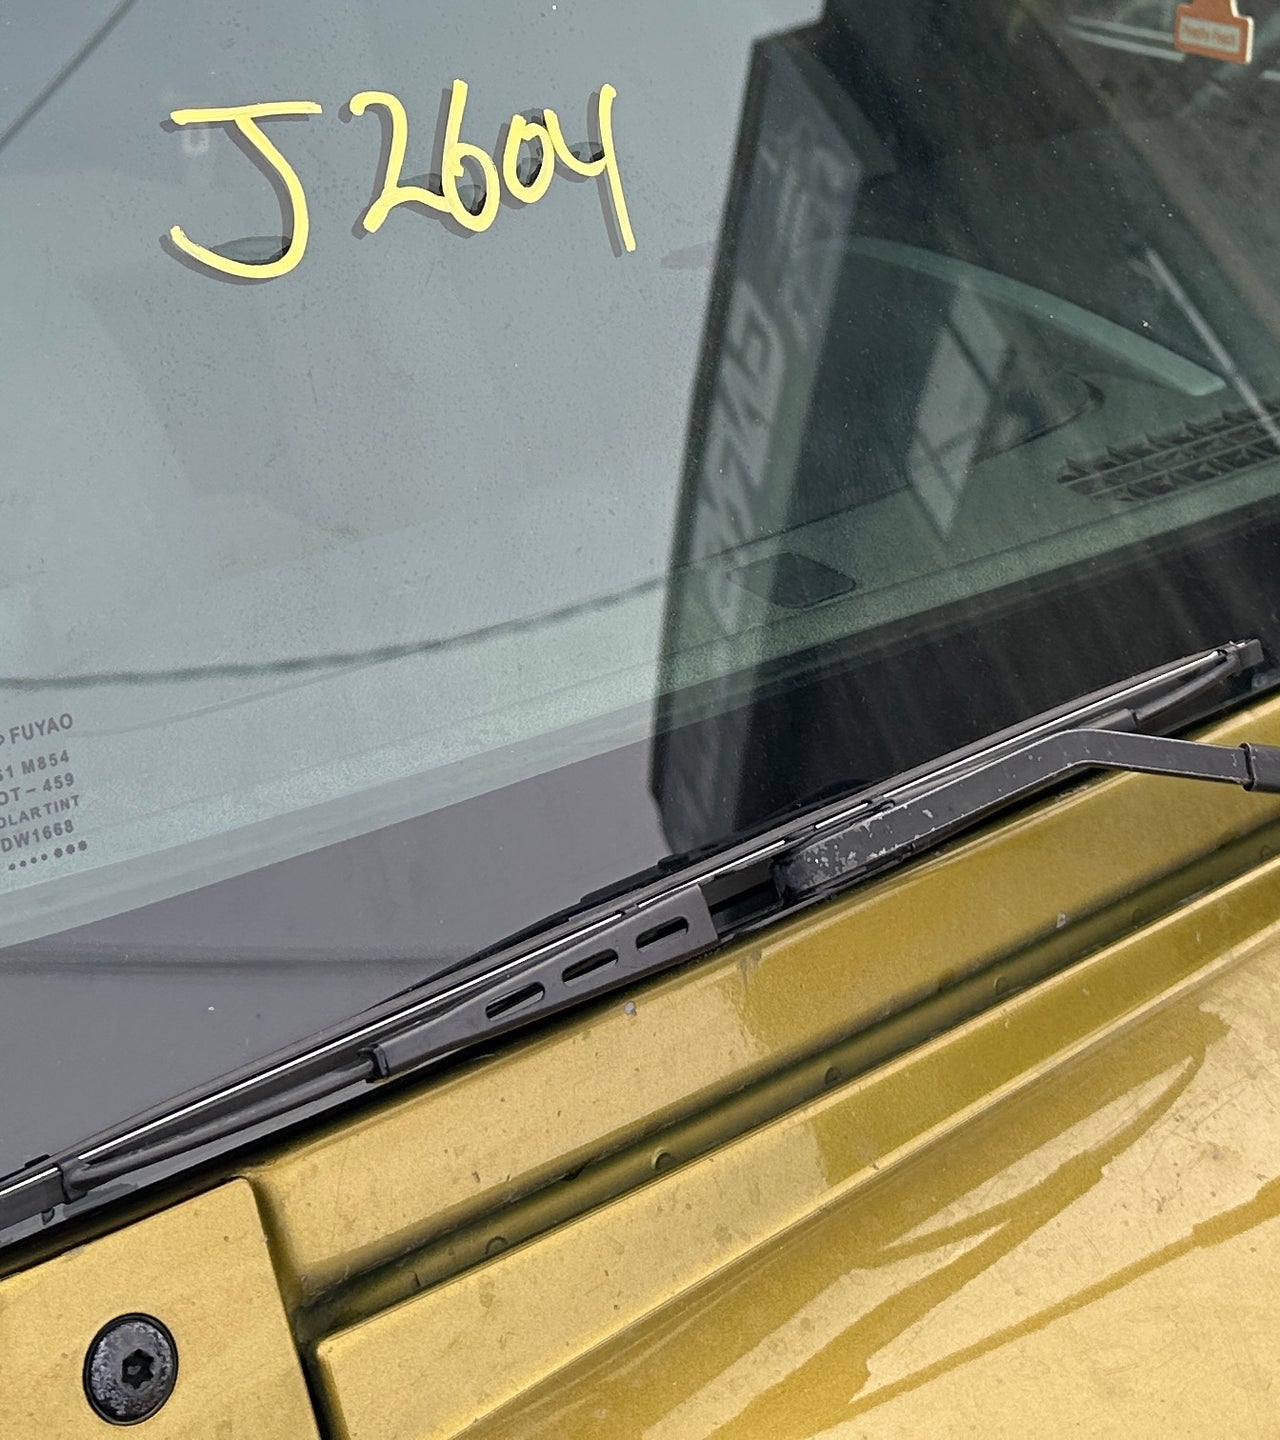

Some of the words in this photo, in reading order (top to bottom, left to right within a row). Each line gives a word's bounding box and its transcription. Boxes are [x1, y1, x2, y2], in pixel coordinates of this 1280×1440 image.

[9, 713, 73, 745] FUYAO
[21, 749, 70, 776] M854
[0, 819, 75, 853] DW1668
